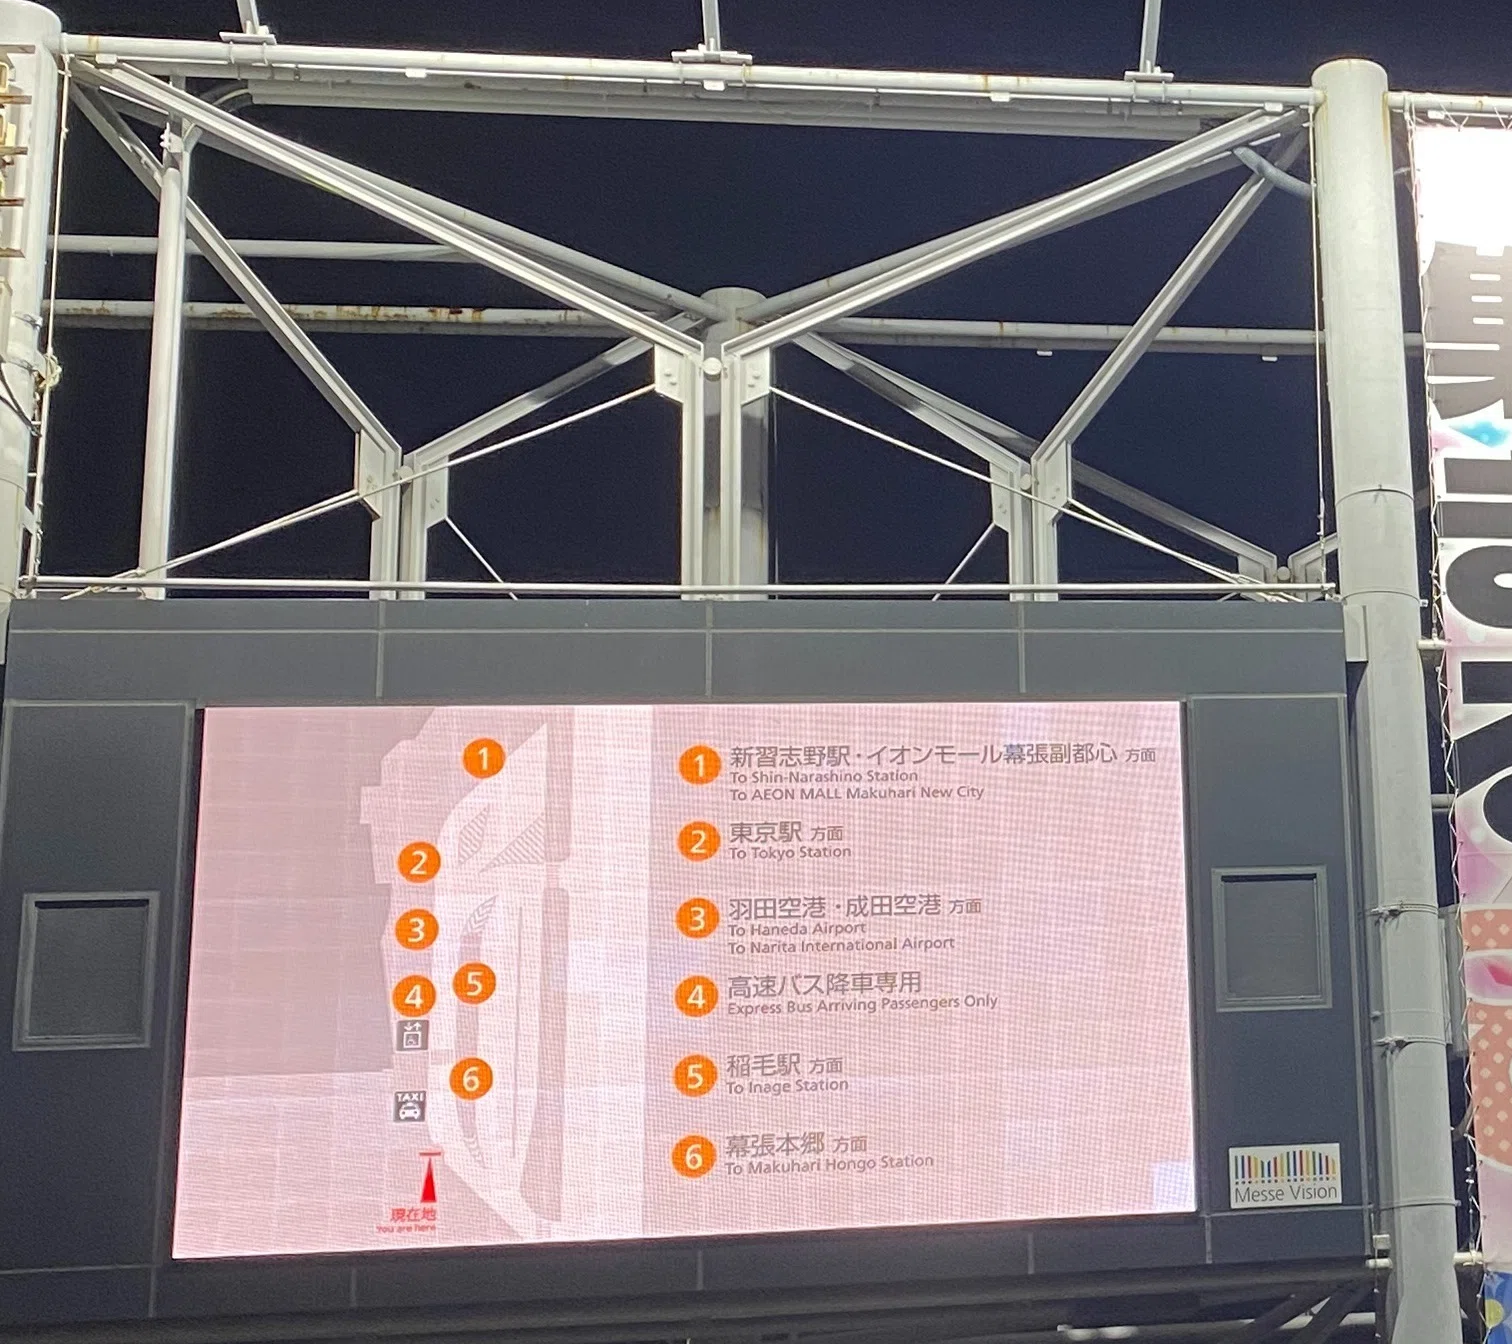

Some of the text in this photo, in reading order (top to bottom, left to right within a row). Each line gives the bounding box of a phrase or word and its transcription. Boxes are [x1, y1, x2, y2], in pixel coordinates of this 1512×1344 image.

[730, 743, 1155, 768] 新習志野駅・イオンモール幕張副都心 方面
[730, 769, 918, 784] To Shin-Narashino Station
[730, 785, 984, 801] To AEON MALL Makuhari New City
[730, 821, 843, 843] 東京駅 方面
[730, 845, 851, 862] To Tokyo Station
[728, 894, 982, 920] 羽田空港・成田空港 方面
[729, 921, 867, 937] To Haneda Airport
[729, 936, 955, 955] To Narita International Airport
[728, 971, 921, 999] 高速バス降車専用
[728, 994, 998, 1017] Express Bus Arriving Passengers Only
[727, 1053, 843, 1078] 稲毛駅 方面
[727, 1079, 849, 1096] To Inage Station
[397, 1093, 424, 1102] TAXI
[726, 1132, 867, 1157] 幕張本郷 方面
[725, 1154, 934, 1176] To Makuhari Hongo Station
[1235, 1183, 1338, 1203] Messe Vision
[390, 1208, 437, 1222] 現在地
[376, 1223, 436, 1233] You are here
